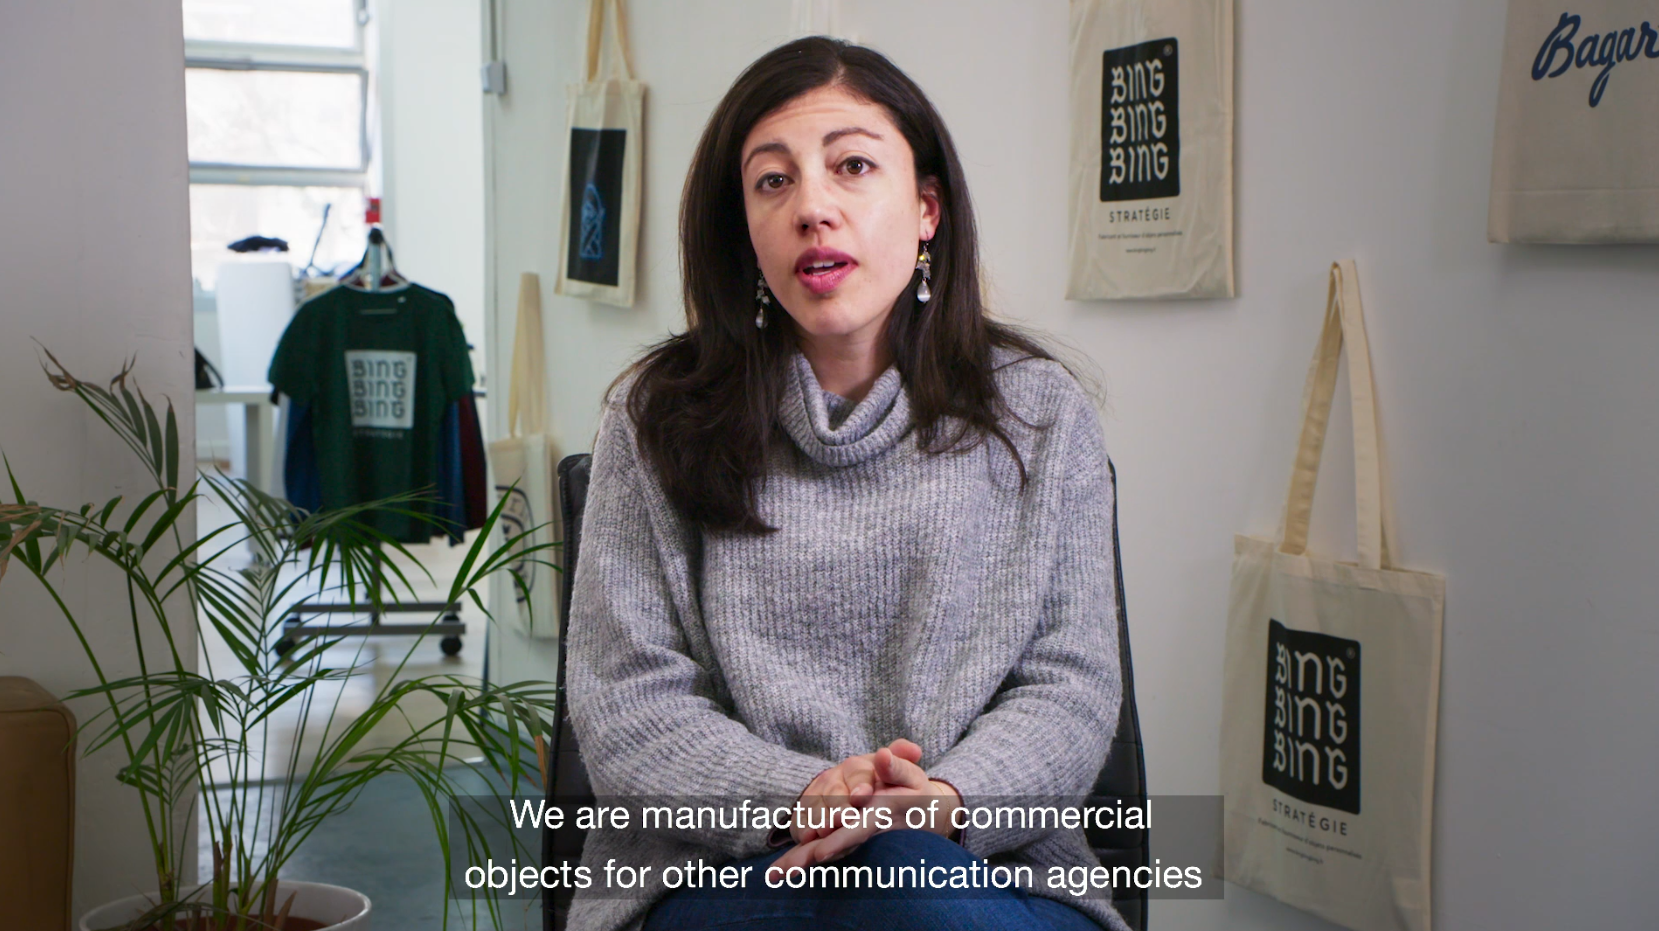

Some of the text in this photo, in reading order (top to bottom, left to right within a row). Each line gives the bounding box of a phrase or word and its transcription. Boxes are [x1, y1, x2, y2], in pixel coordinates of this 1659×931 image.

[1531, 12, 1659, 108] Bagar
[1109, 206, 1170, 223] STRATÉGIE
[1272, 798, 1348, 836] STRATÉGIE
